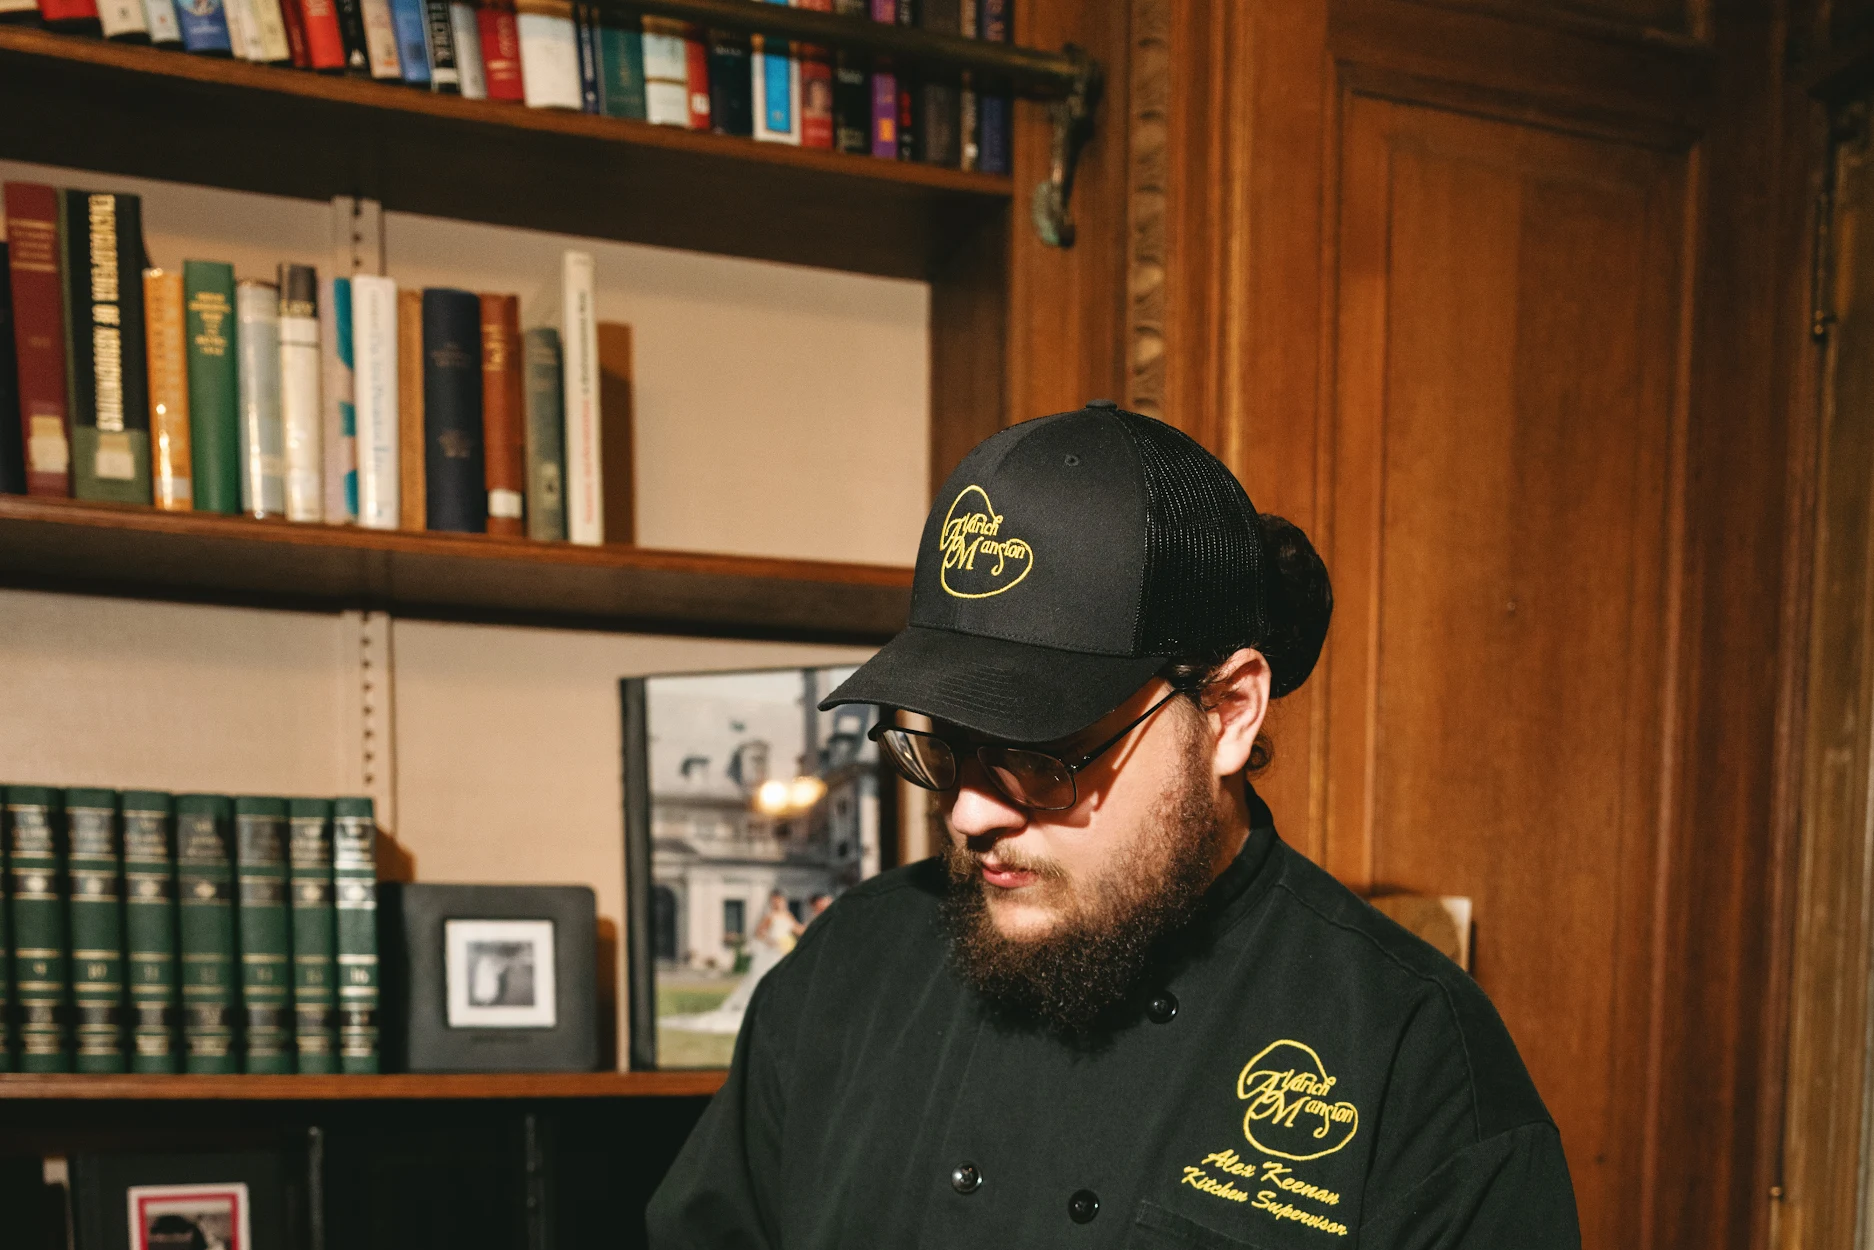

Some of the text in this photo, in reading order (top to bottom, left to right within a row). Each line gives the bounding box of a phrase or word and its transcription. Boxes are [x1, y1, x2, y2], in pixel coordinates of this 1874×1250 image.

[1180, 1165, 1348, 1237] Kitchen Supervisor
[1201, 1148, 1341, 1206] Alex Keenan
